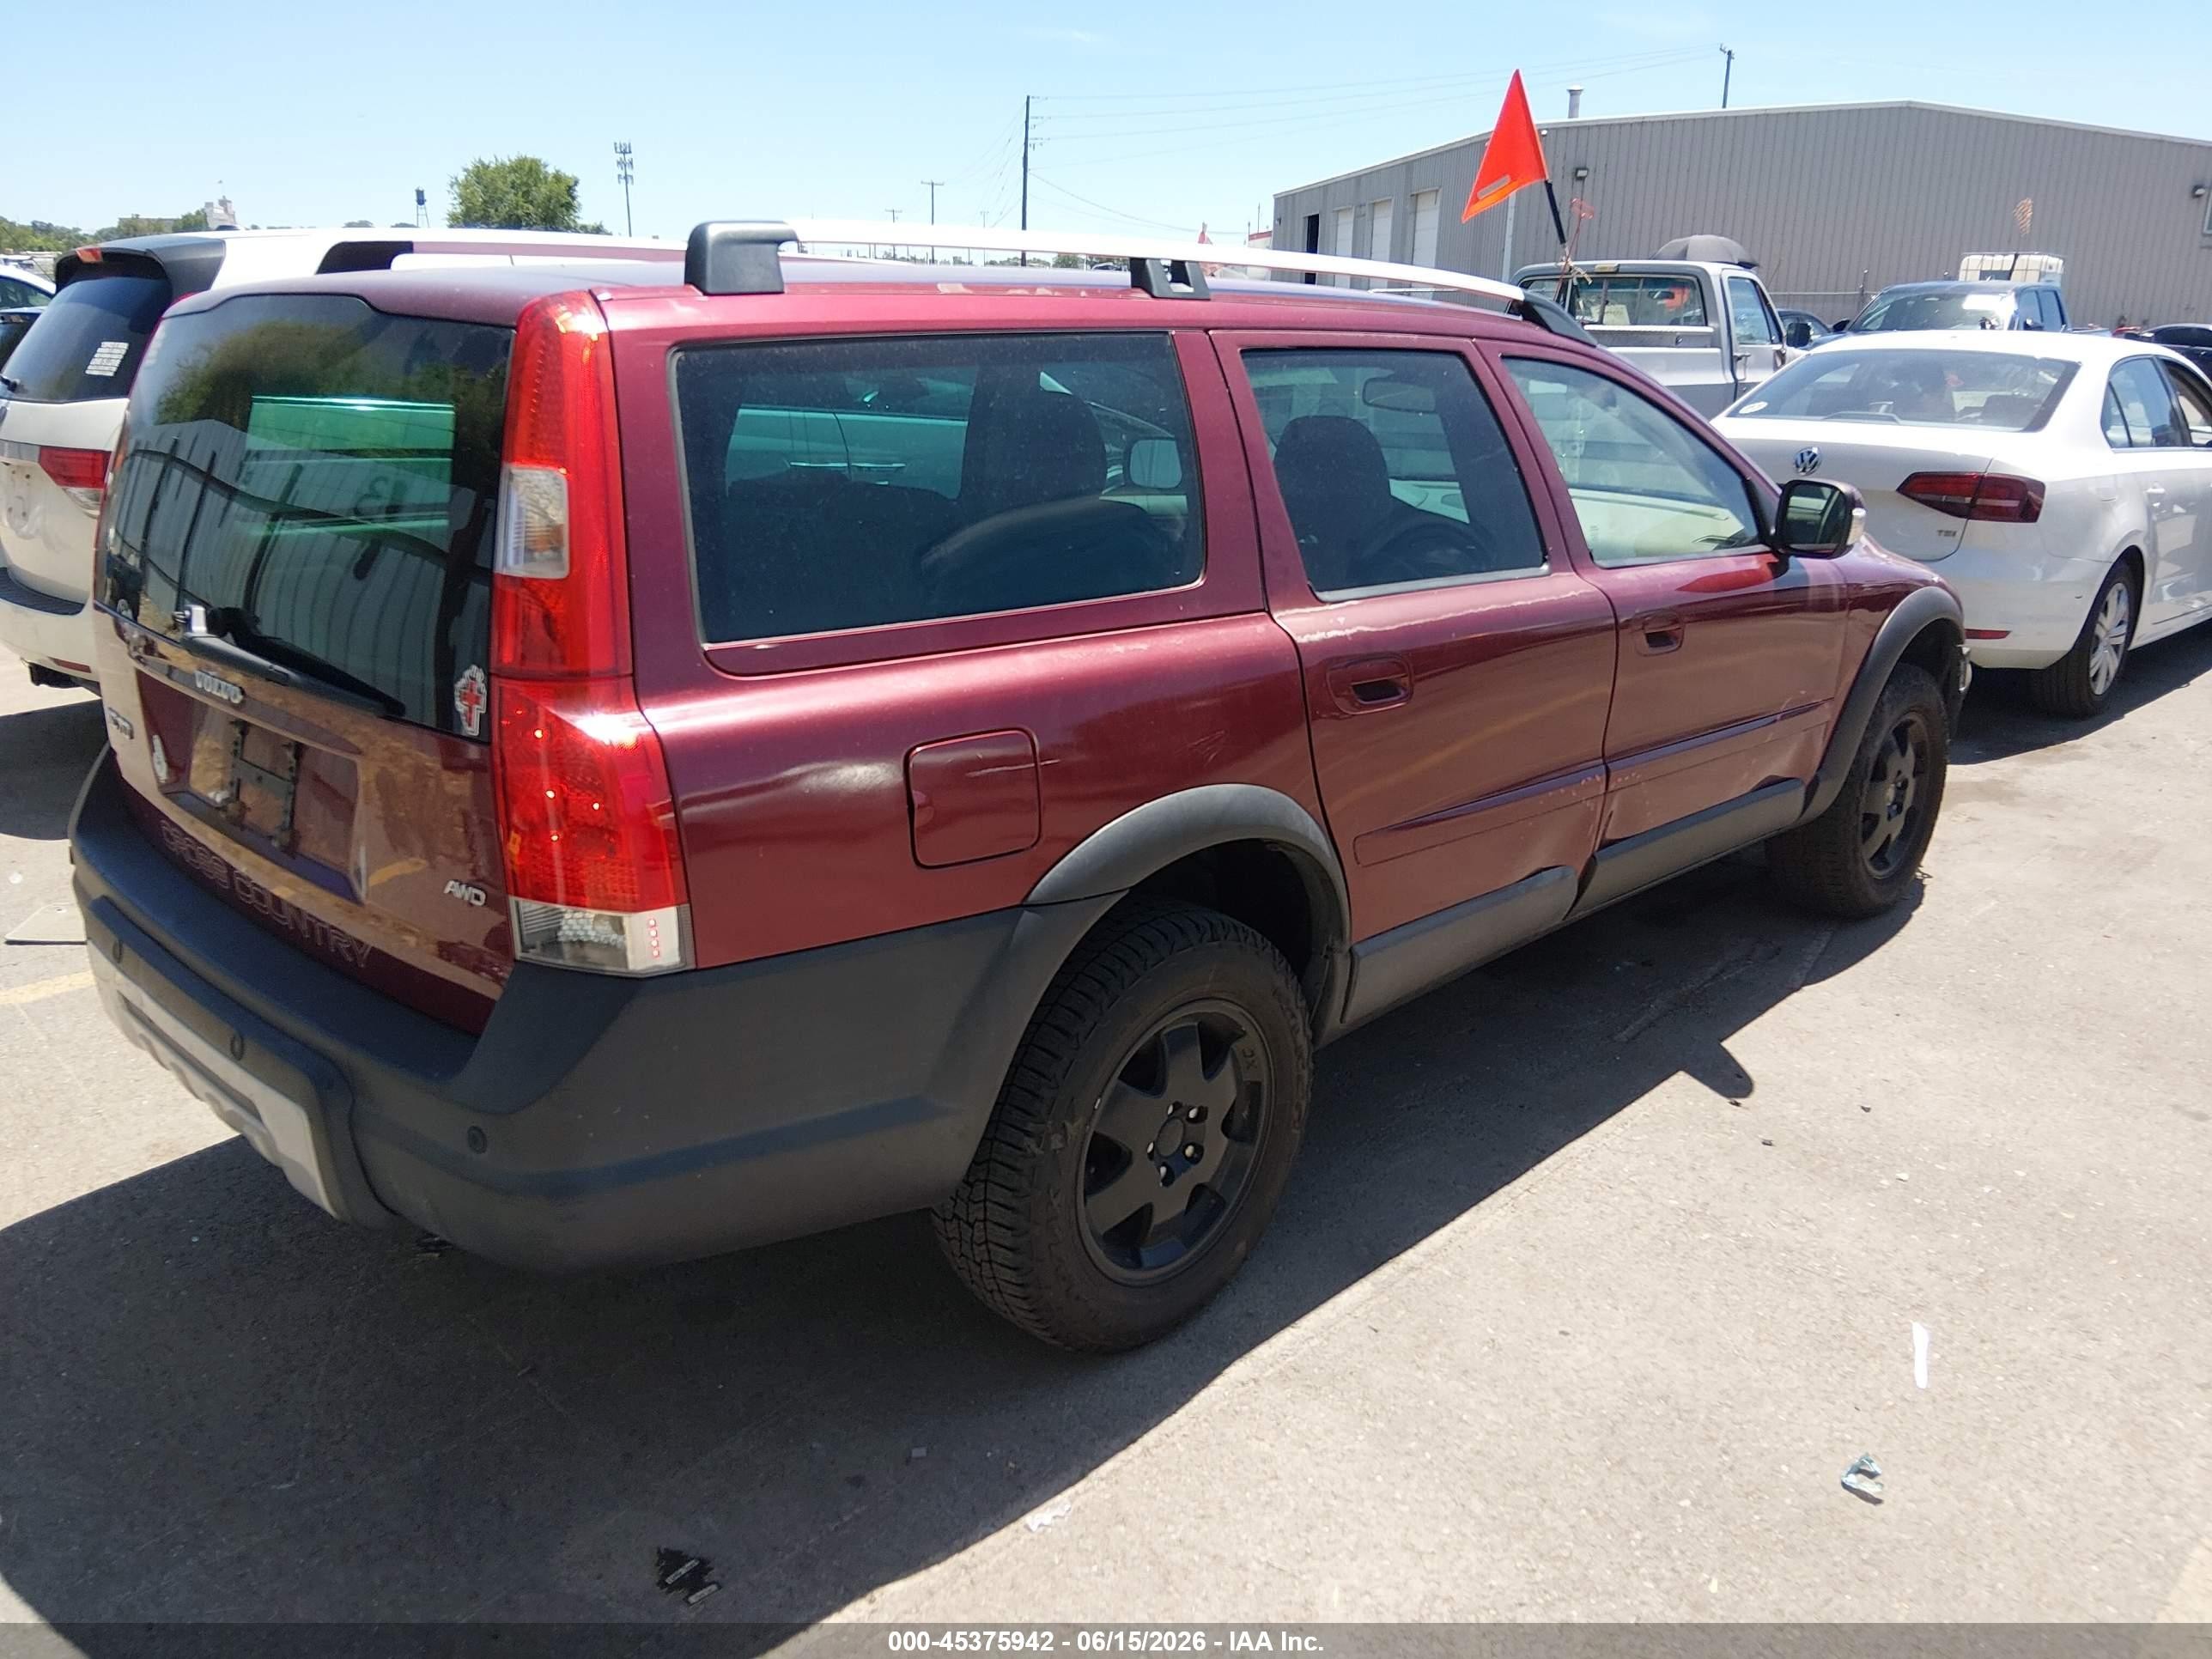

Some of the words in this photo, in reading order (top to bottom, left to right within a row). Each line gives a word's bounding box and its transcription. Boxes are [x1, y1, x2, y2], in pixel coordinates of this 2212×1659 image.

[192, 669, 245, 704] VOLVO
[159, 818, 232, 890] CROSS
[233, 870, 373, 969] COUNTRY
[443, 878, 487, 907] AWD
